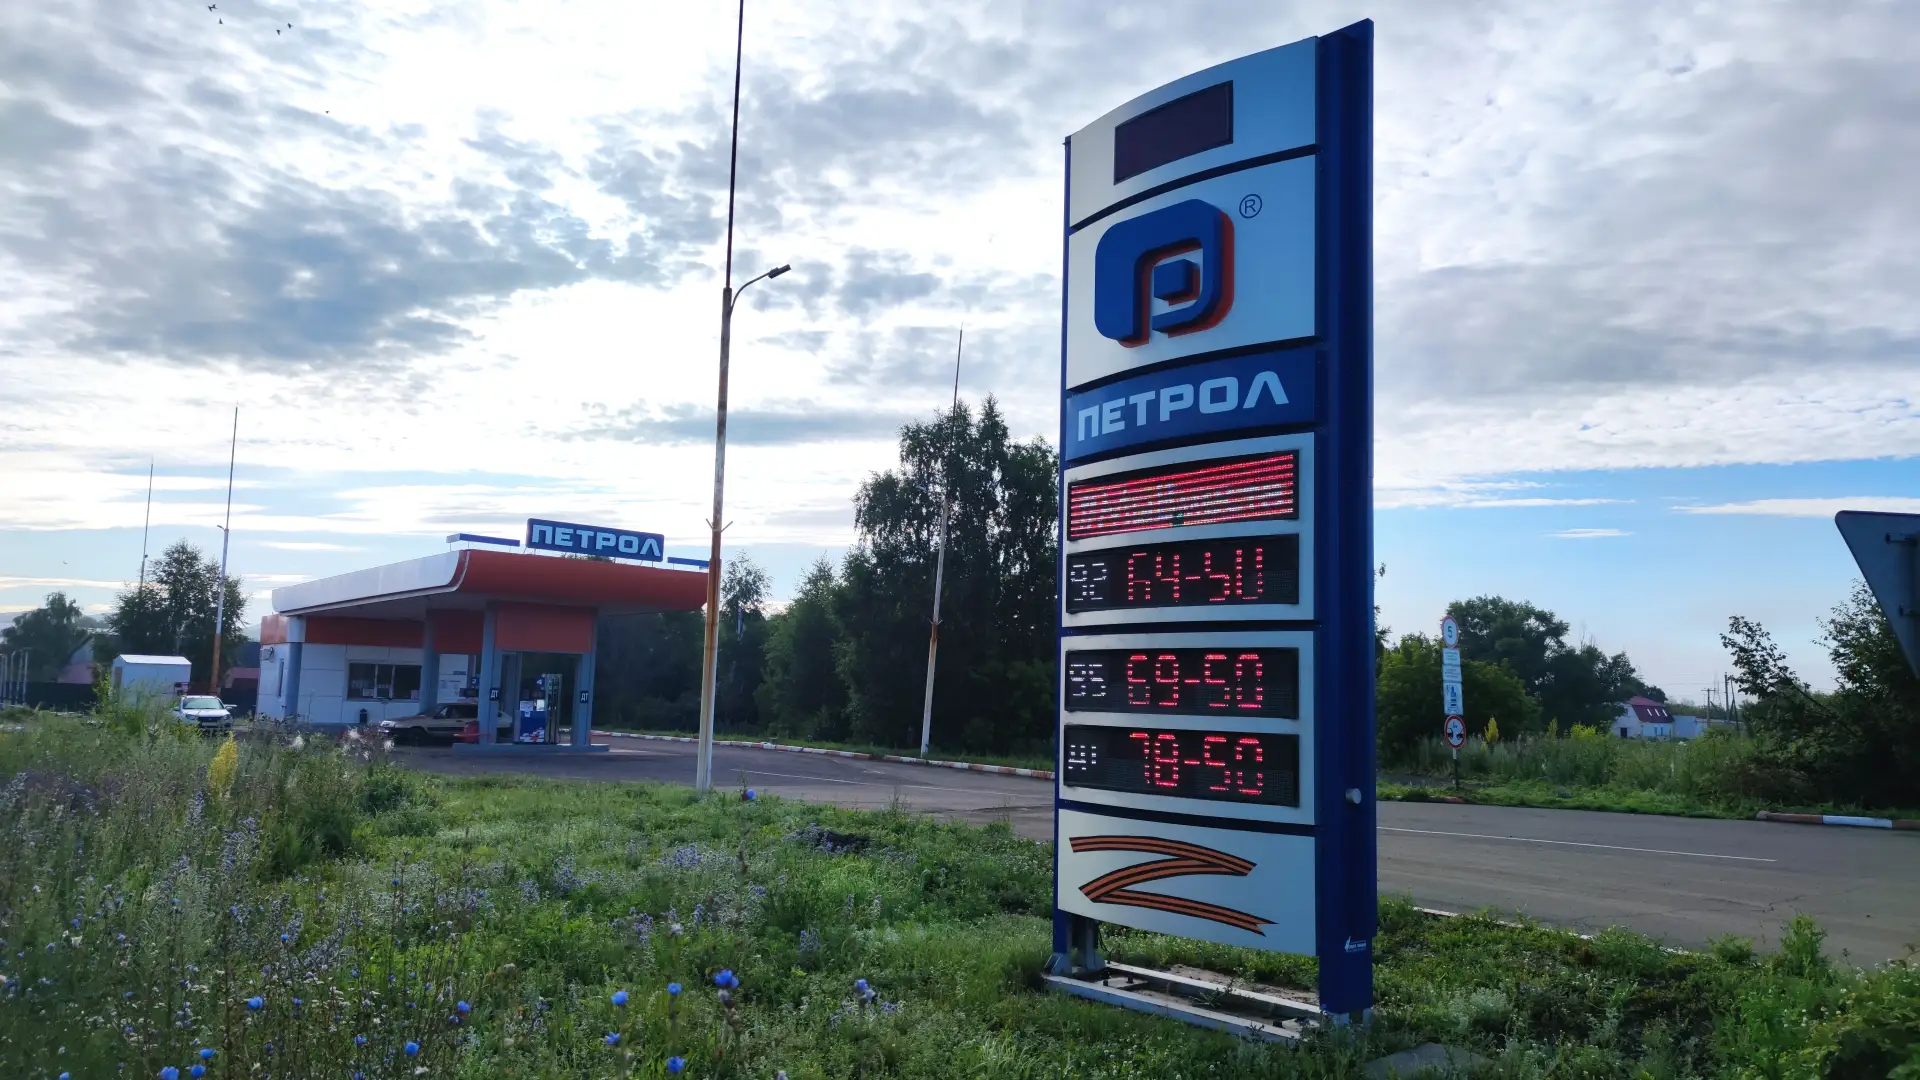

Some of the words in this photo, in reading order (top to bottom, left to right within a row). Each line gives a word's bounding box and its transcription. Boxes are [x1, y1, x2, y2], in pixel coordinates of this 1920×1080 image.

[1077, 370, 1290, 442] ПЕТРОЛ
[531, 523, 661, 557] ПЕТРОЛ
[1447, 626, 1453, 639] 5
[1069, 663, 1106, 697] 95
[1127, 653, 1263, 708] 69-50
[1128, 731, 1263, 795] 78-50
